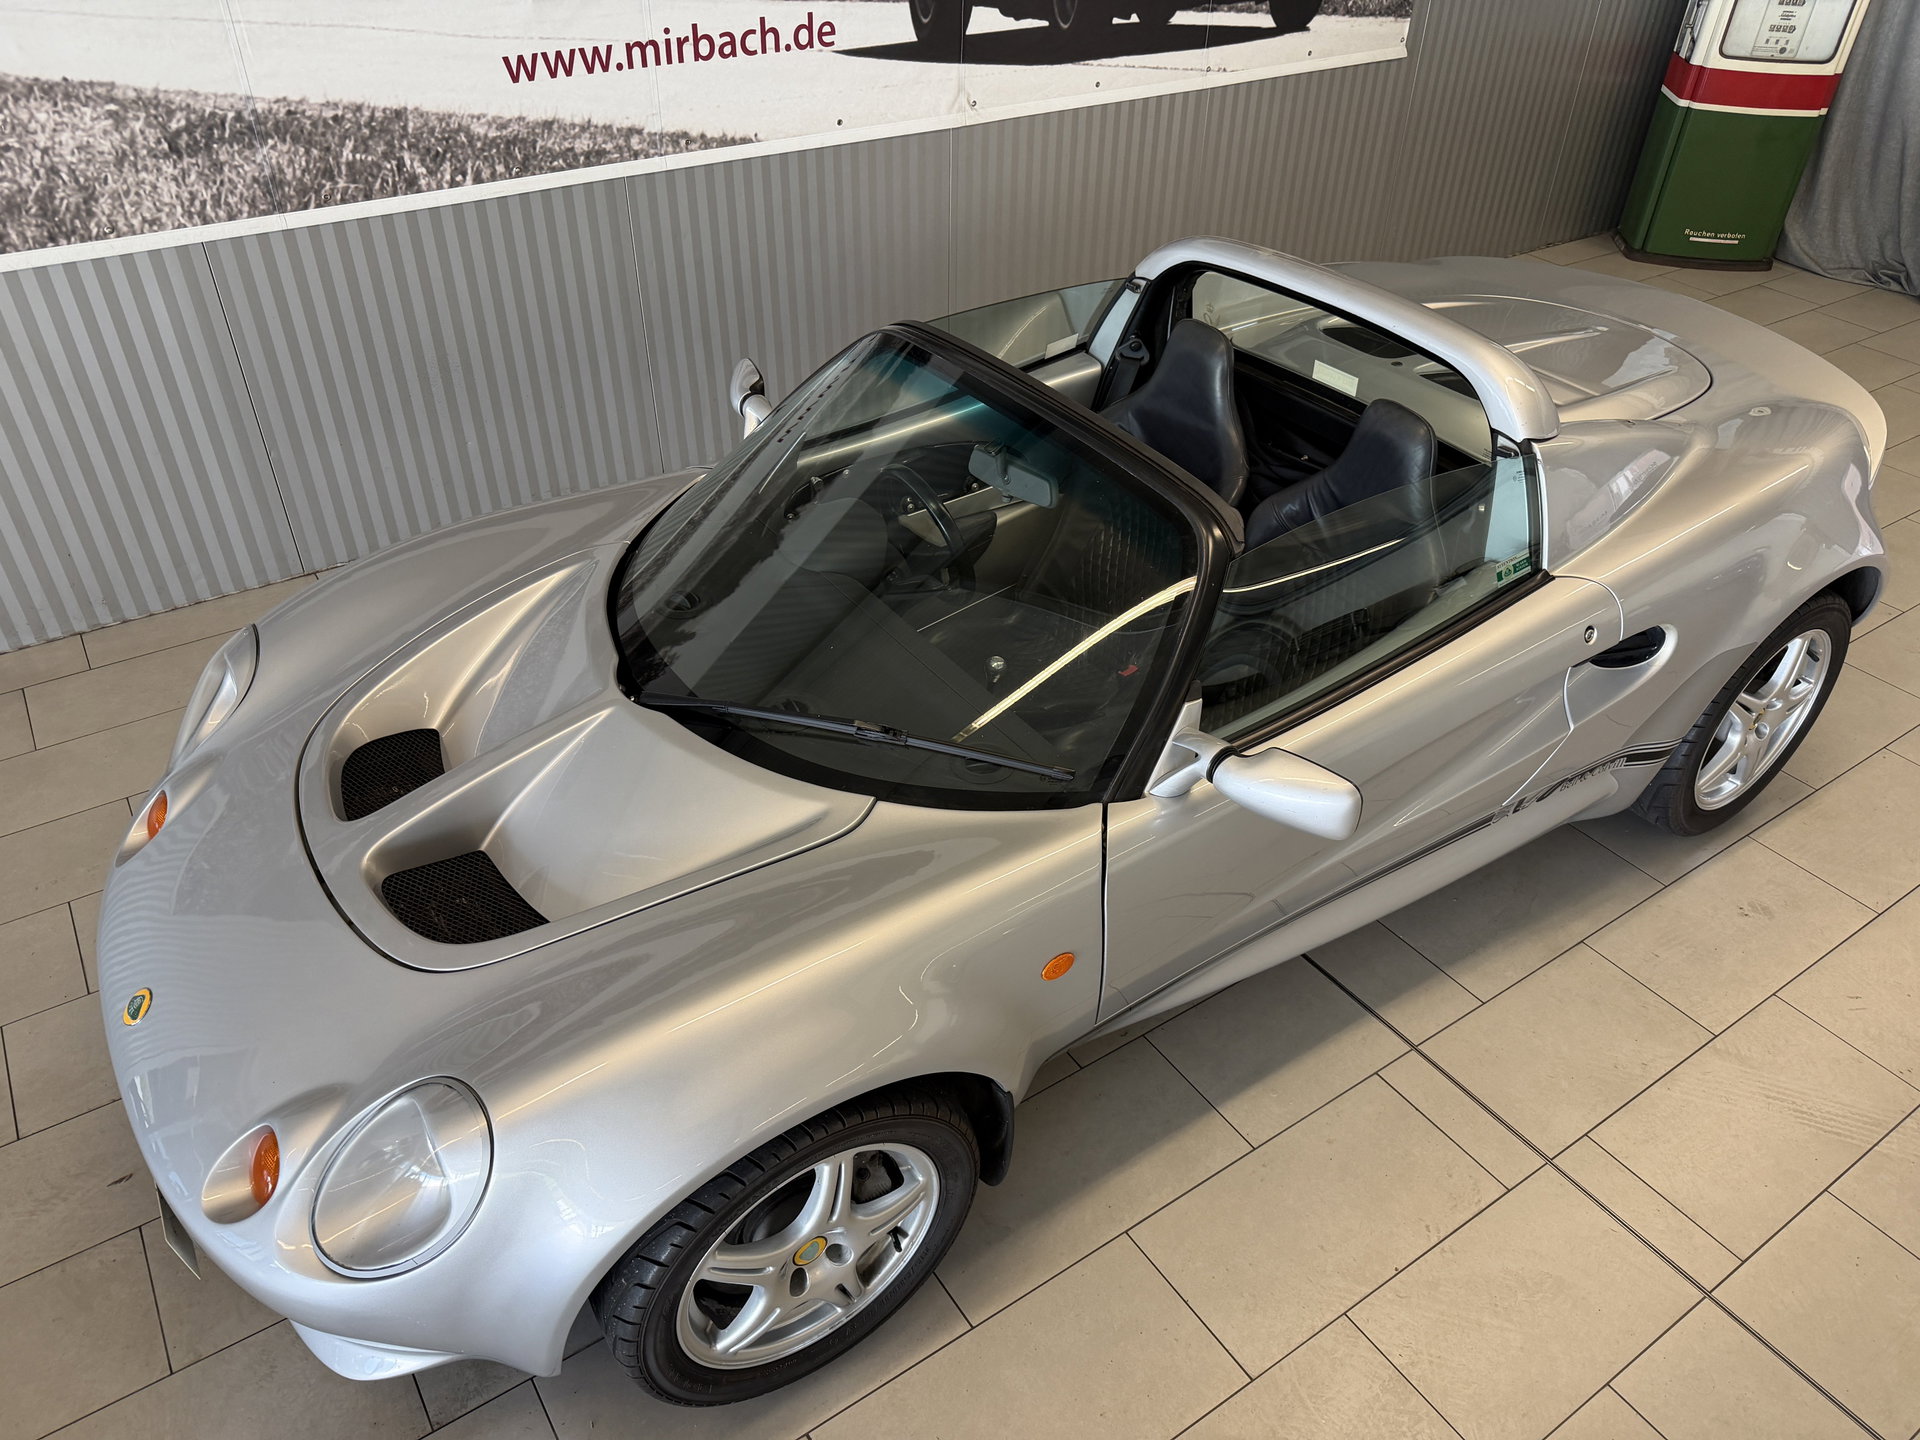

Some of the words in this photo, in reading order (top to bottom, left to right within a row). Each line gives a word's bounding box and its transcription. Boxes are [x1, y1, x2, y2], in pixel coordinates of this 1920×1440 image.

[502, 12, 837, 84] www.mirbach.de
[1684, 228, 1715, 238] Rauchen
[1716, 232, 1746, 240] verboten
